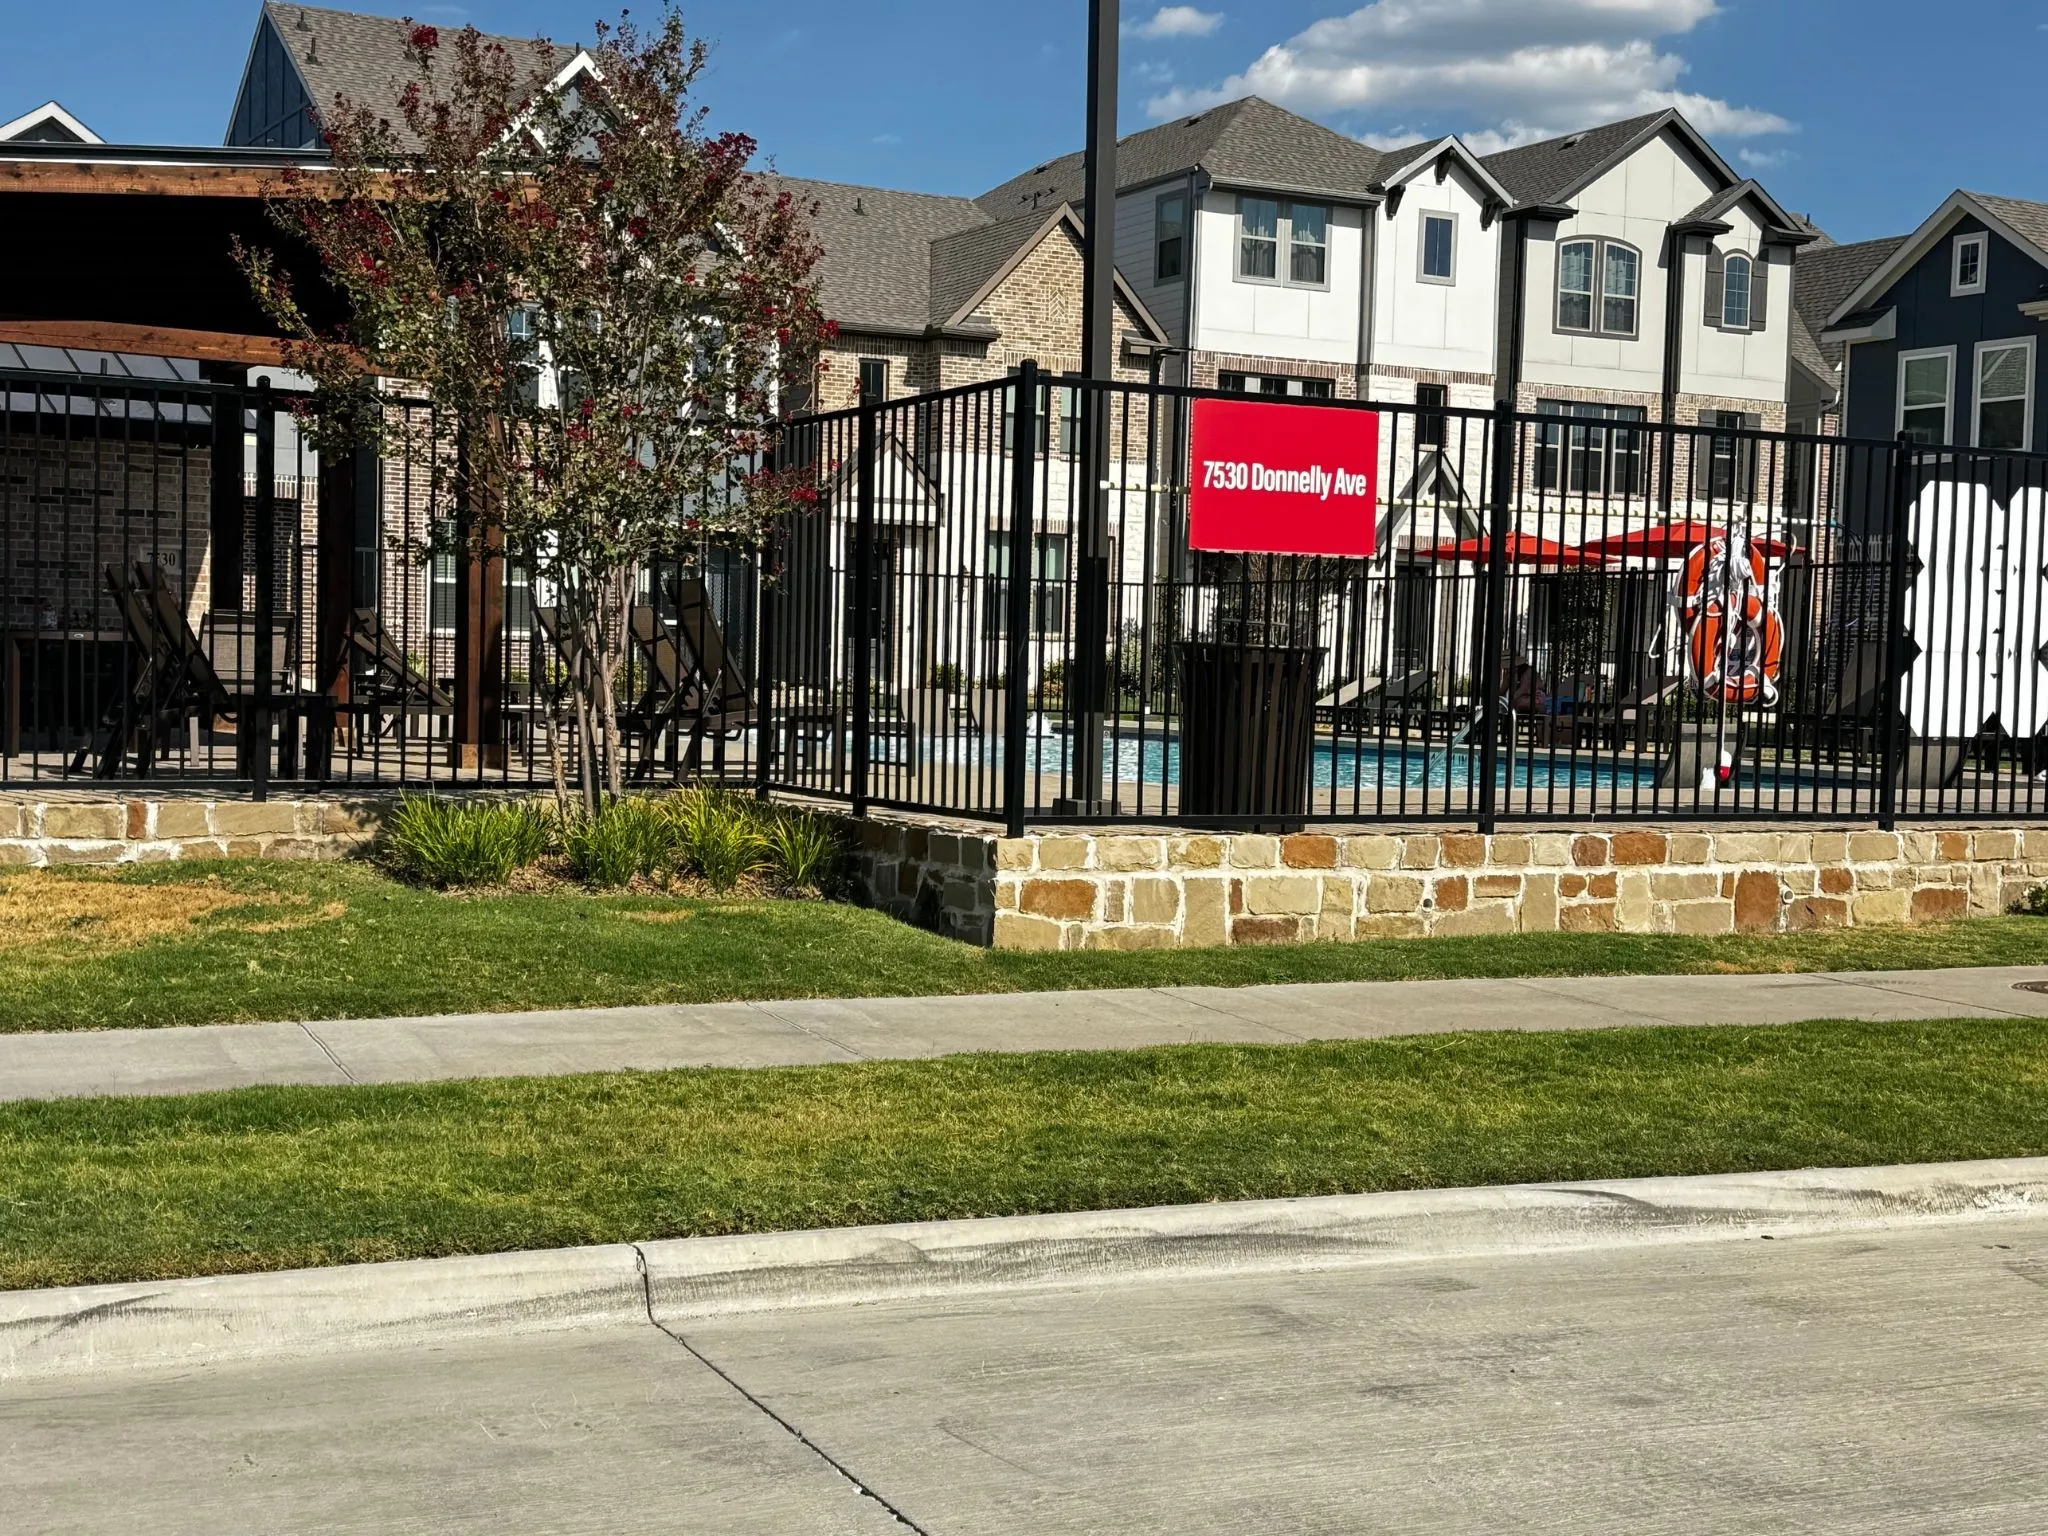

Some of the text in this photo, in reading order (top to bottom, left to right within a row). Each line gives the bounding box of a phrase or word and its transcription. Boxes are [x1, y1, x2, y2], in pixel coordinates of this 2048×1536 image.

[1203, 461, 1367, 501] 7530 Donnelly Ave
